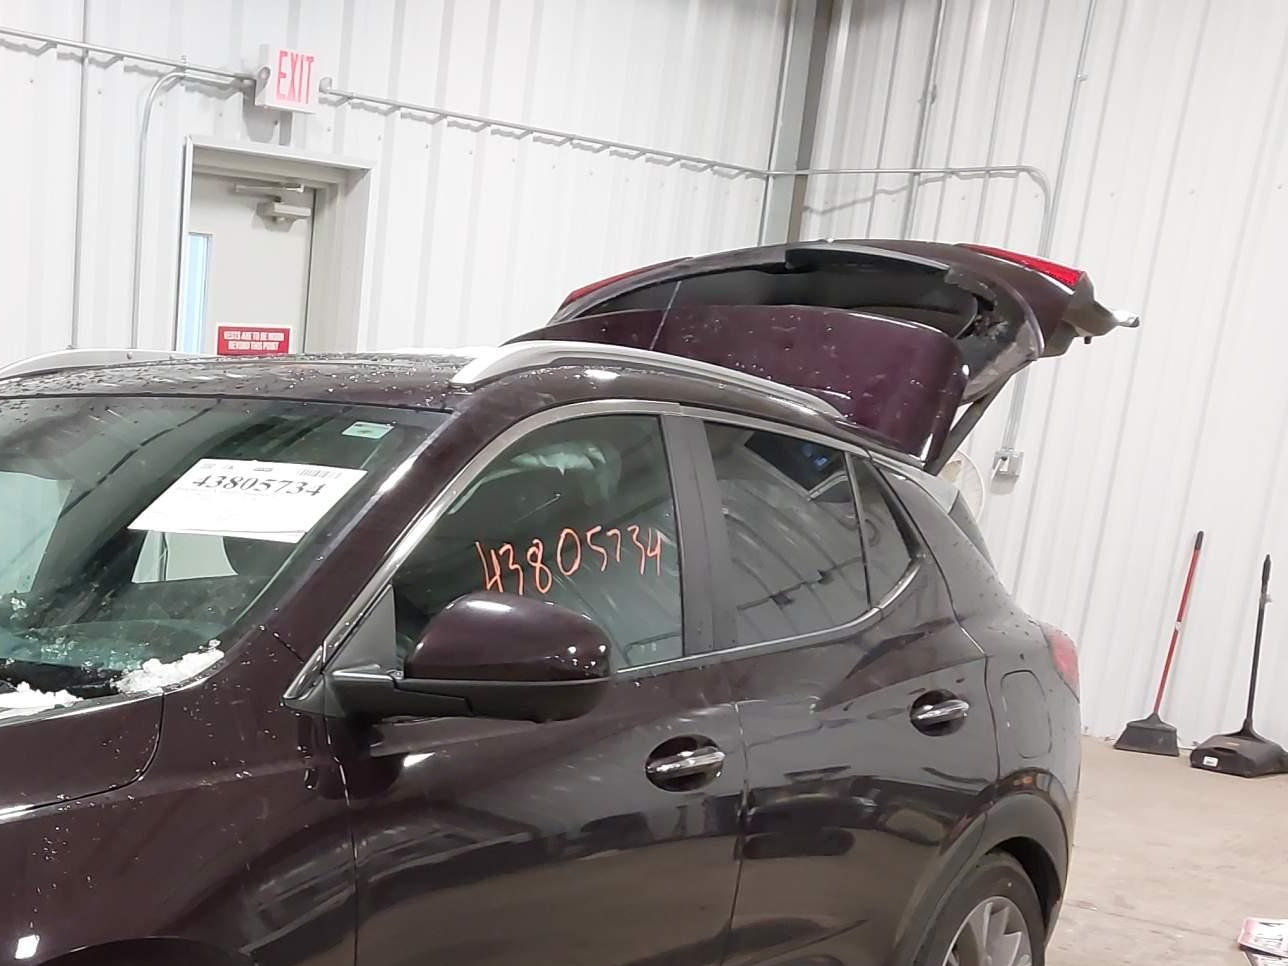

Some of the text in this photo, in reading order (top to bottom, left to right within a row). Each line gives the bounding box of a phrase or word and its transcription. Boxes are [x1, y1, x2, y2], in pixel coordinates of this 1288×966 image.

[275, 49, 315, 105] EXIT
[241, 332, 252, 340] ARE
[253, 332, 260, 340] TO
[260, 332, 267, 341] BE
[251, 342, 262, 350] THIS
[192, 475, 327, 497] 43805734
[474, 524, 662, 596] 43805734
